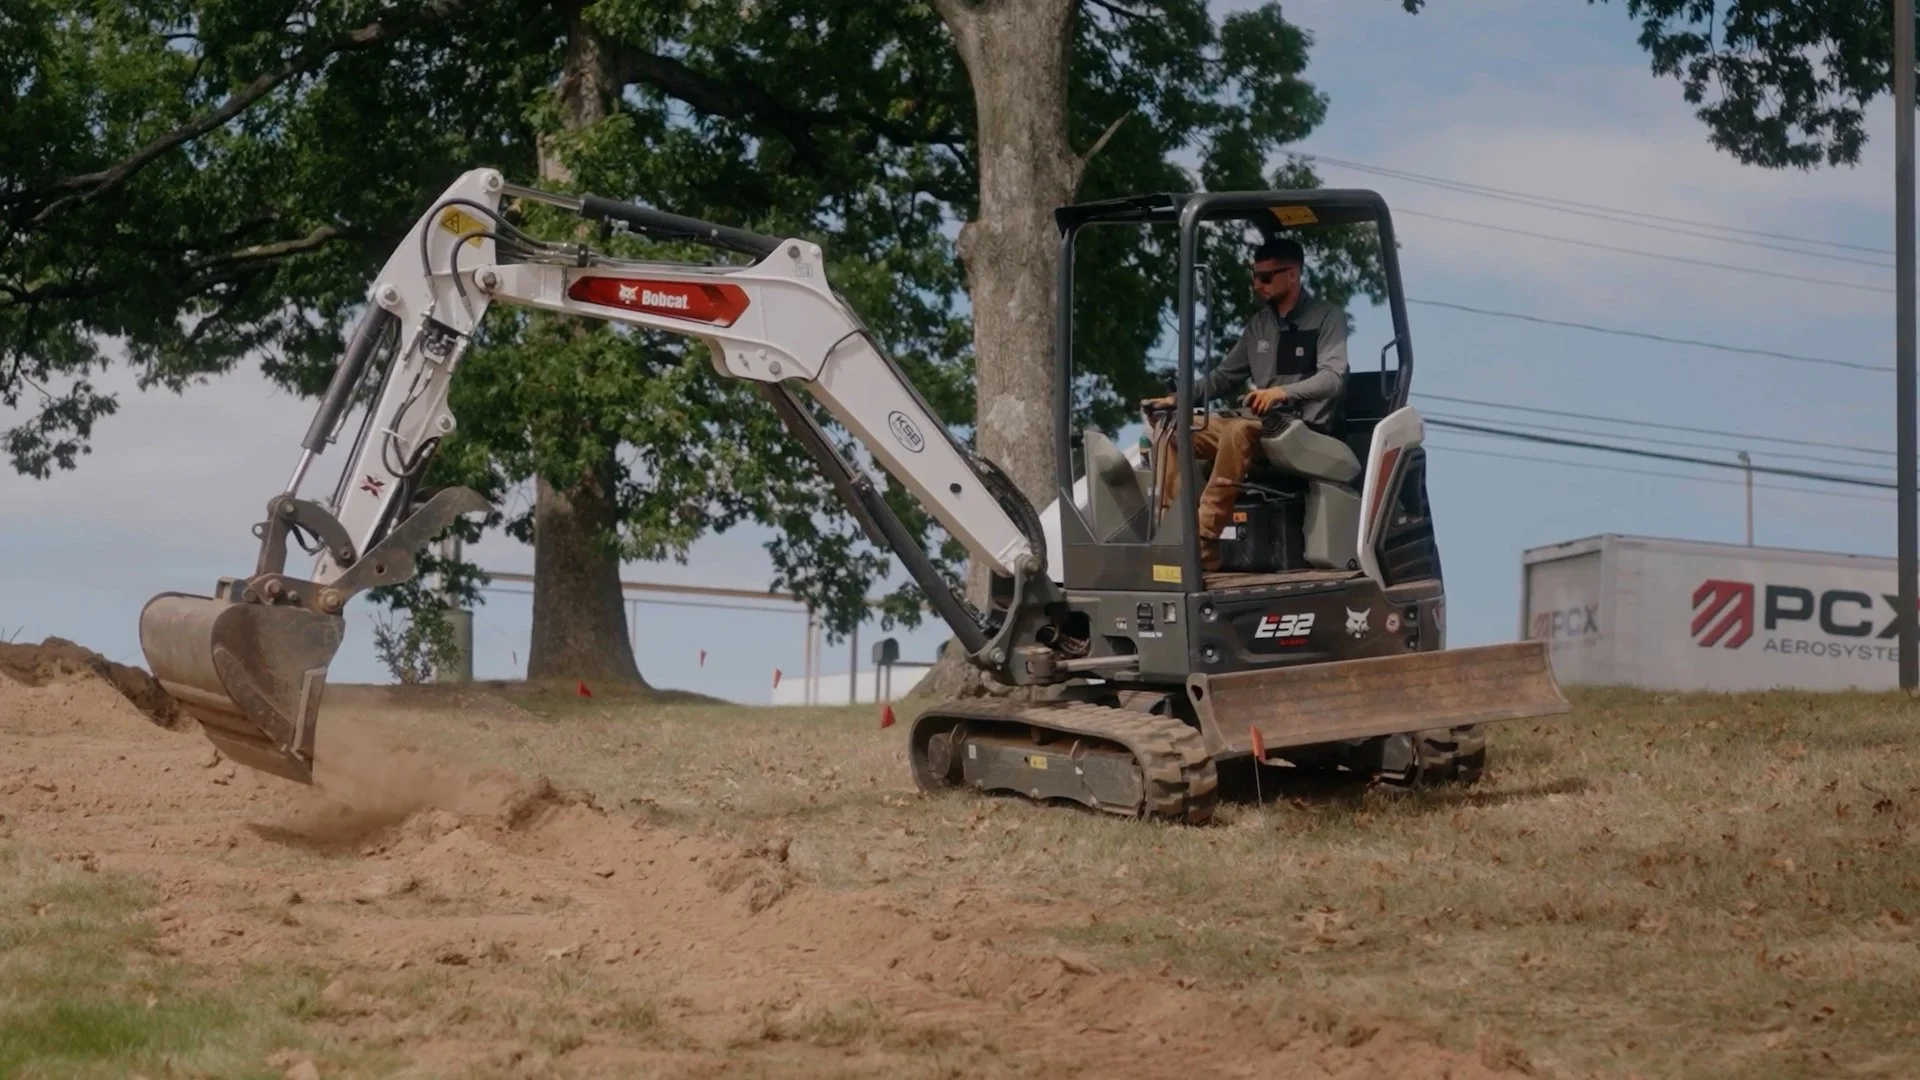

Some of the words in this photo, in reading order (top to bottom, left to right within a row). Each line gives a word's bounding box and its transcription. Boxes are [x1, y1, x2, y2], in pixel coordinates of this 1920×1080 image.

[642, 289, 689, 309] Bobcat
[895, 415, 921, 445] KSB
[1254, 612, 1316, 639] E32
[1551, 604, 1599, 639] PCX
